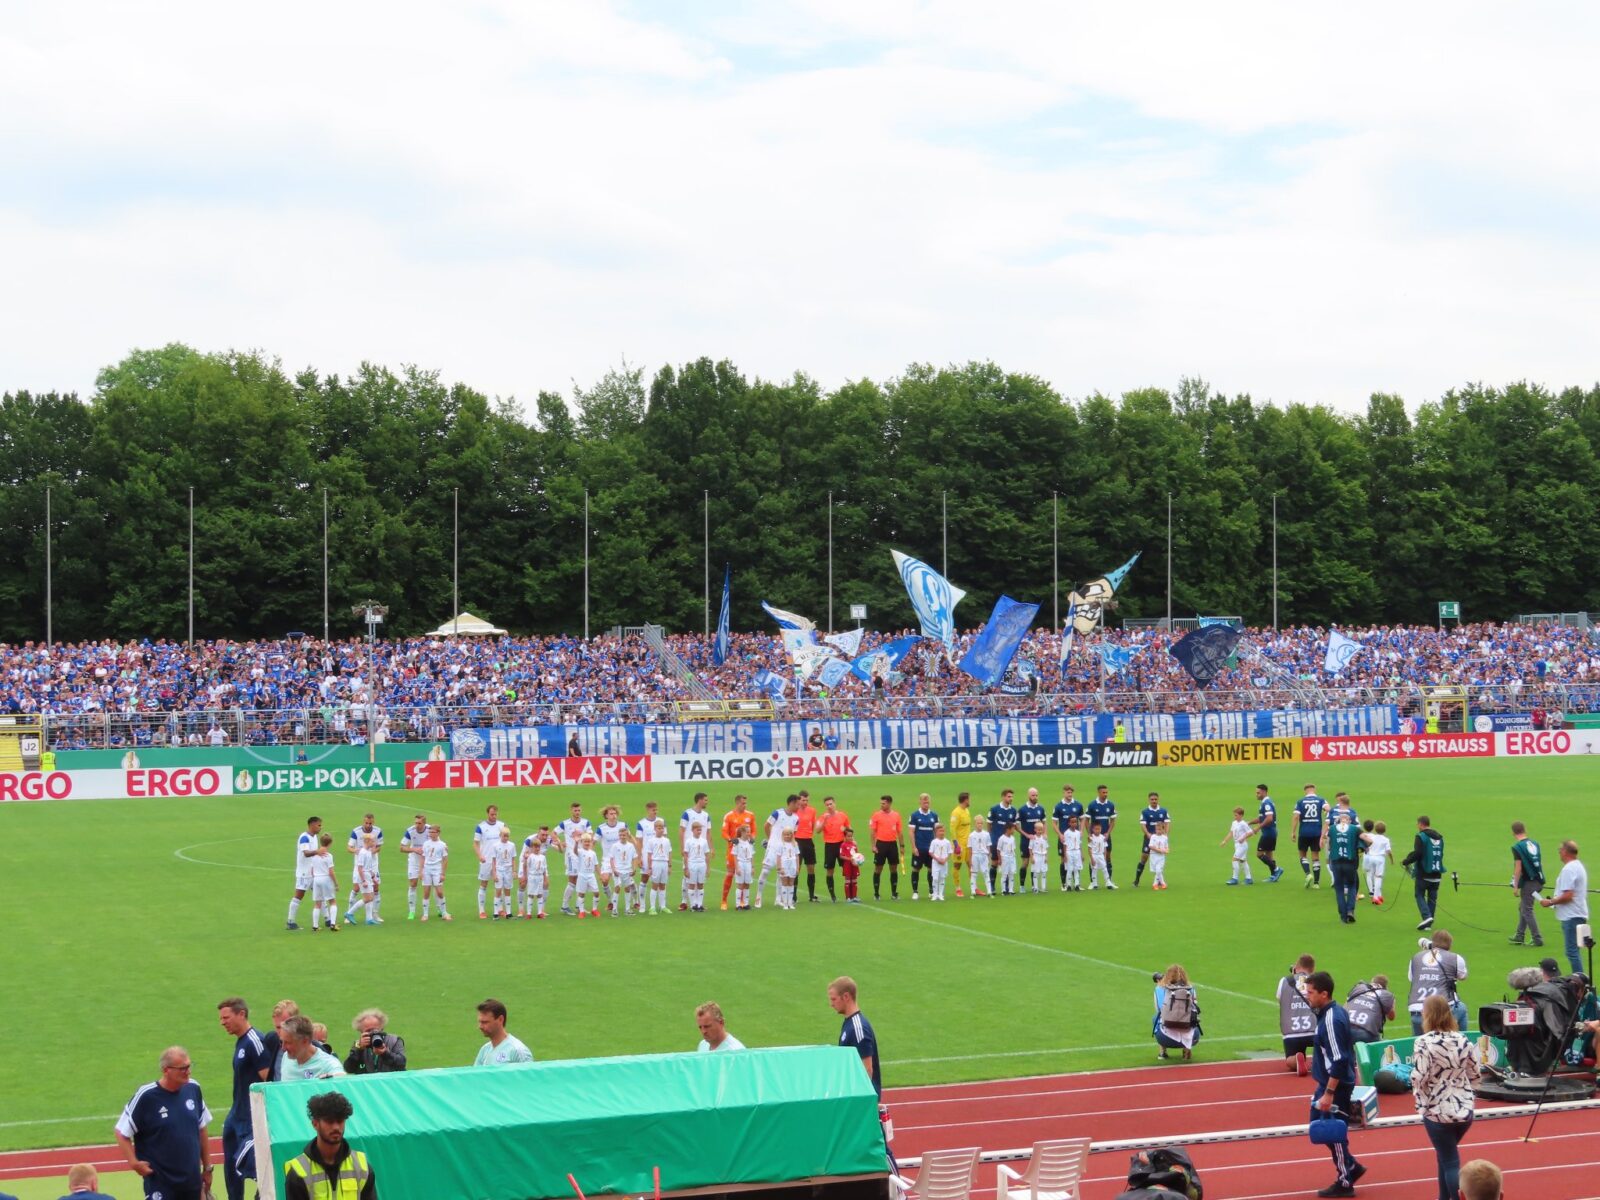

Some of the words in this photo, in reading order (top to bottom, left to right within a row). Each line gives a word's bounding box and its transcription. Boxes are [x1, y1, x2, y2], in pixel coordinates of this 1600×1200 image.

[644, 722, 753, 755] EINZIGES
[1058, 716, 1098, 744] IST
[1418, 737, 1488, 754] STRAUSS
[1505, 731, 1571, 755] ERGO
[25, 742, 37, 751] J2
[1102, 744, 1153, 767] bwin
[1169, 742, 1292, 763] SPORTWETTEN
[1327, 740, 1398, 757] STRAUSS
[914, 753, 947, 770] Der
[951, 751, 988, 769] ID.5
[1022, 750, 1054, 767] Der
[1057, 748, 1093, 765] ID.5
[126, 767, 220, 797] ERGO
[256, 766, 398, 791] DFB-POKAL
[445, 757, 646, 788] FLYERALARM
[1304, 803, 1318, 818] 28
[1291, 1015, 1312, 1031] 33
